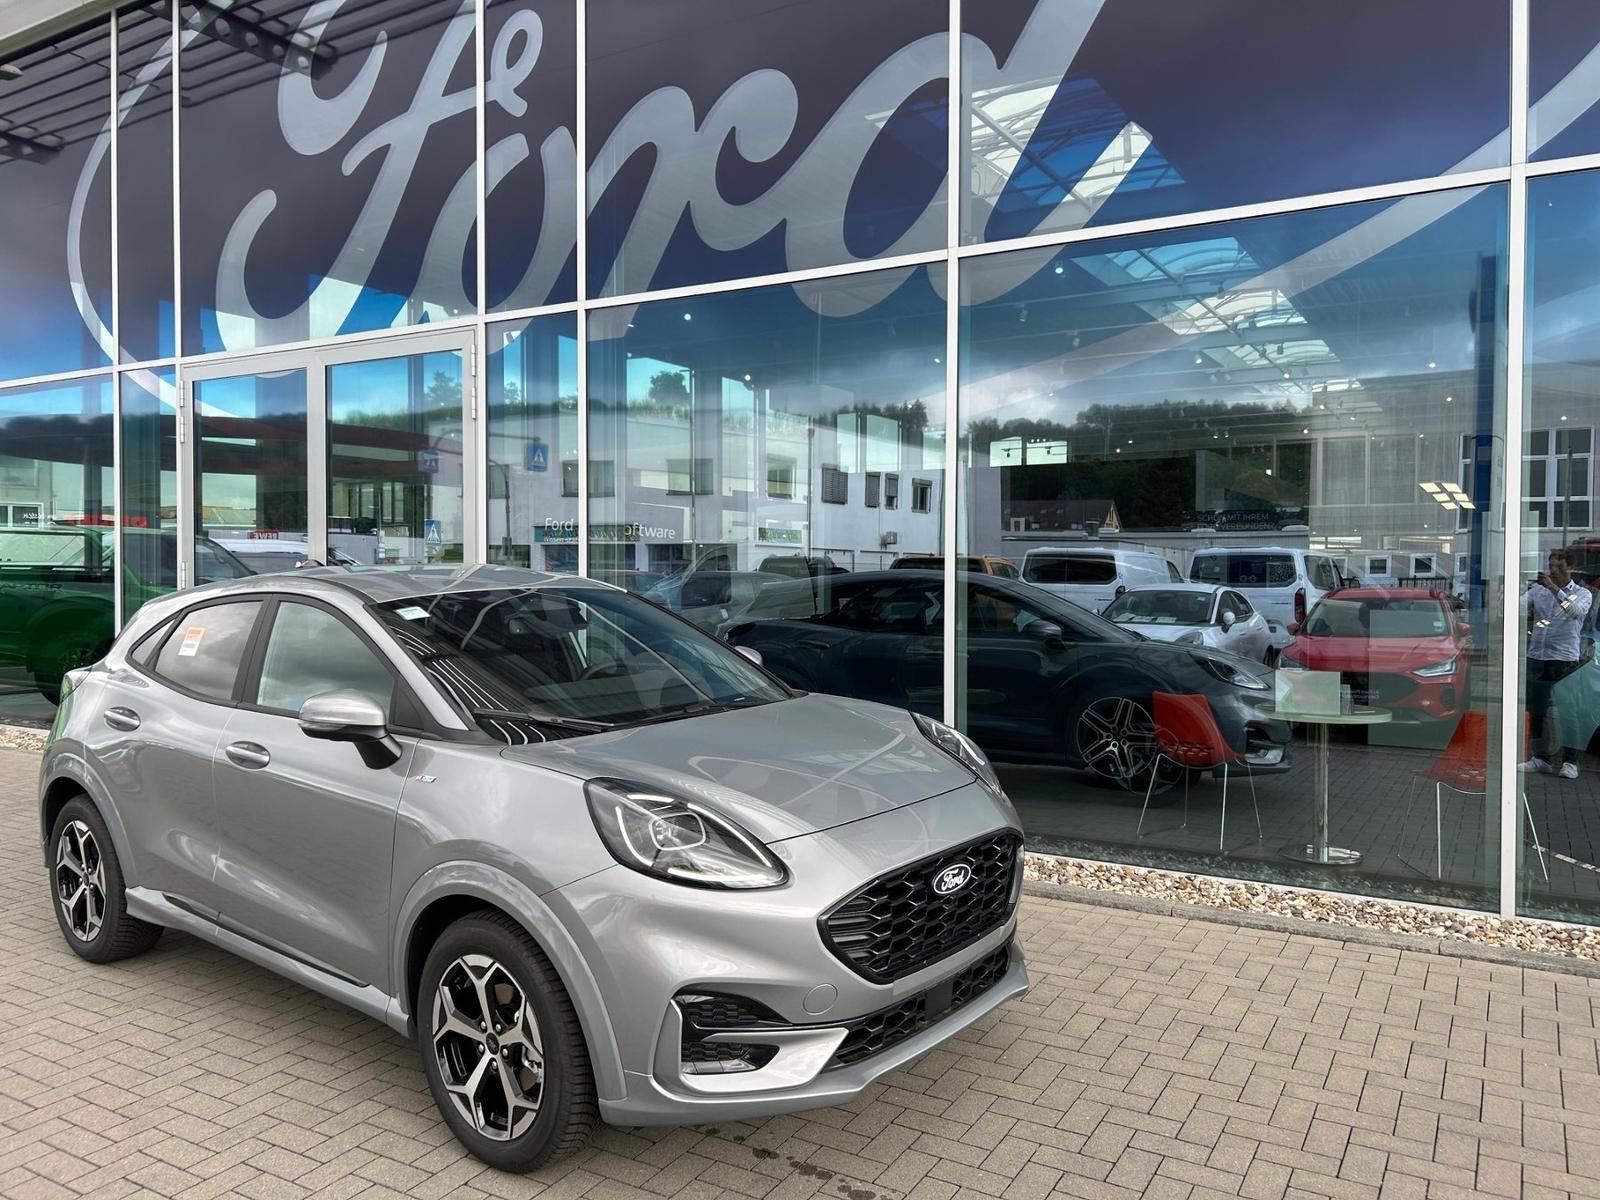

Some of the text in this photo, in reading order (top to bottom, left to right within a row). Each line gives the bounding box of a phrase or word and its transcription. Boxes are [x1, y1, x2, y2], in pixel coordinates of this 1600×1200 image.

[216, 0, 1153, 375] Ford
[544, 517, 574, 531] Ford
[941, 868, 965, 892] Ford
